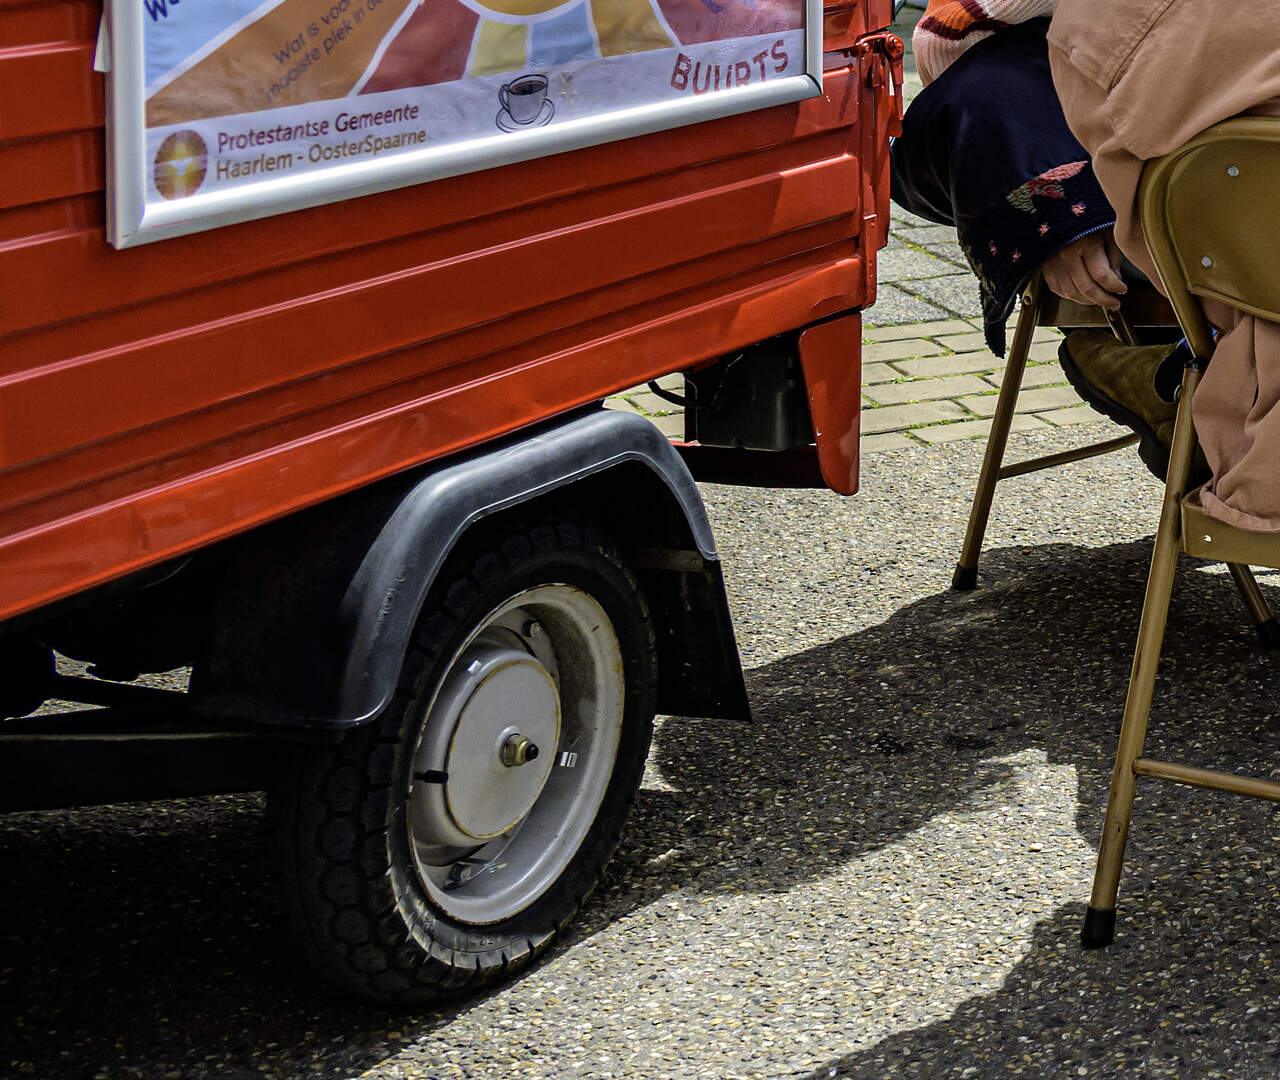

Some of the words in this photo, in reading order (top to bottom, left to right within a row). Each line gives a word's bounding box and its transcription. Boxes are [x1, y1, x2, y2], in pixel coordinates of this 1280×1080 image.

[272, 33, 306, 65] Wat
[307, 22, 320, 38] is
[323, 21, 354, 54] plek
[352, 8, 366, 24] in
[670, 39, 789, 95] BUURTS
[217, 119, 329, 153] Protestantse
[335, 104, 420, 132] Gemeente
[216, 152, 292, 181] Haarlem
[309, 128, 427, 164] OosterSpaarne
